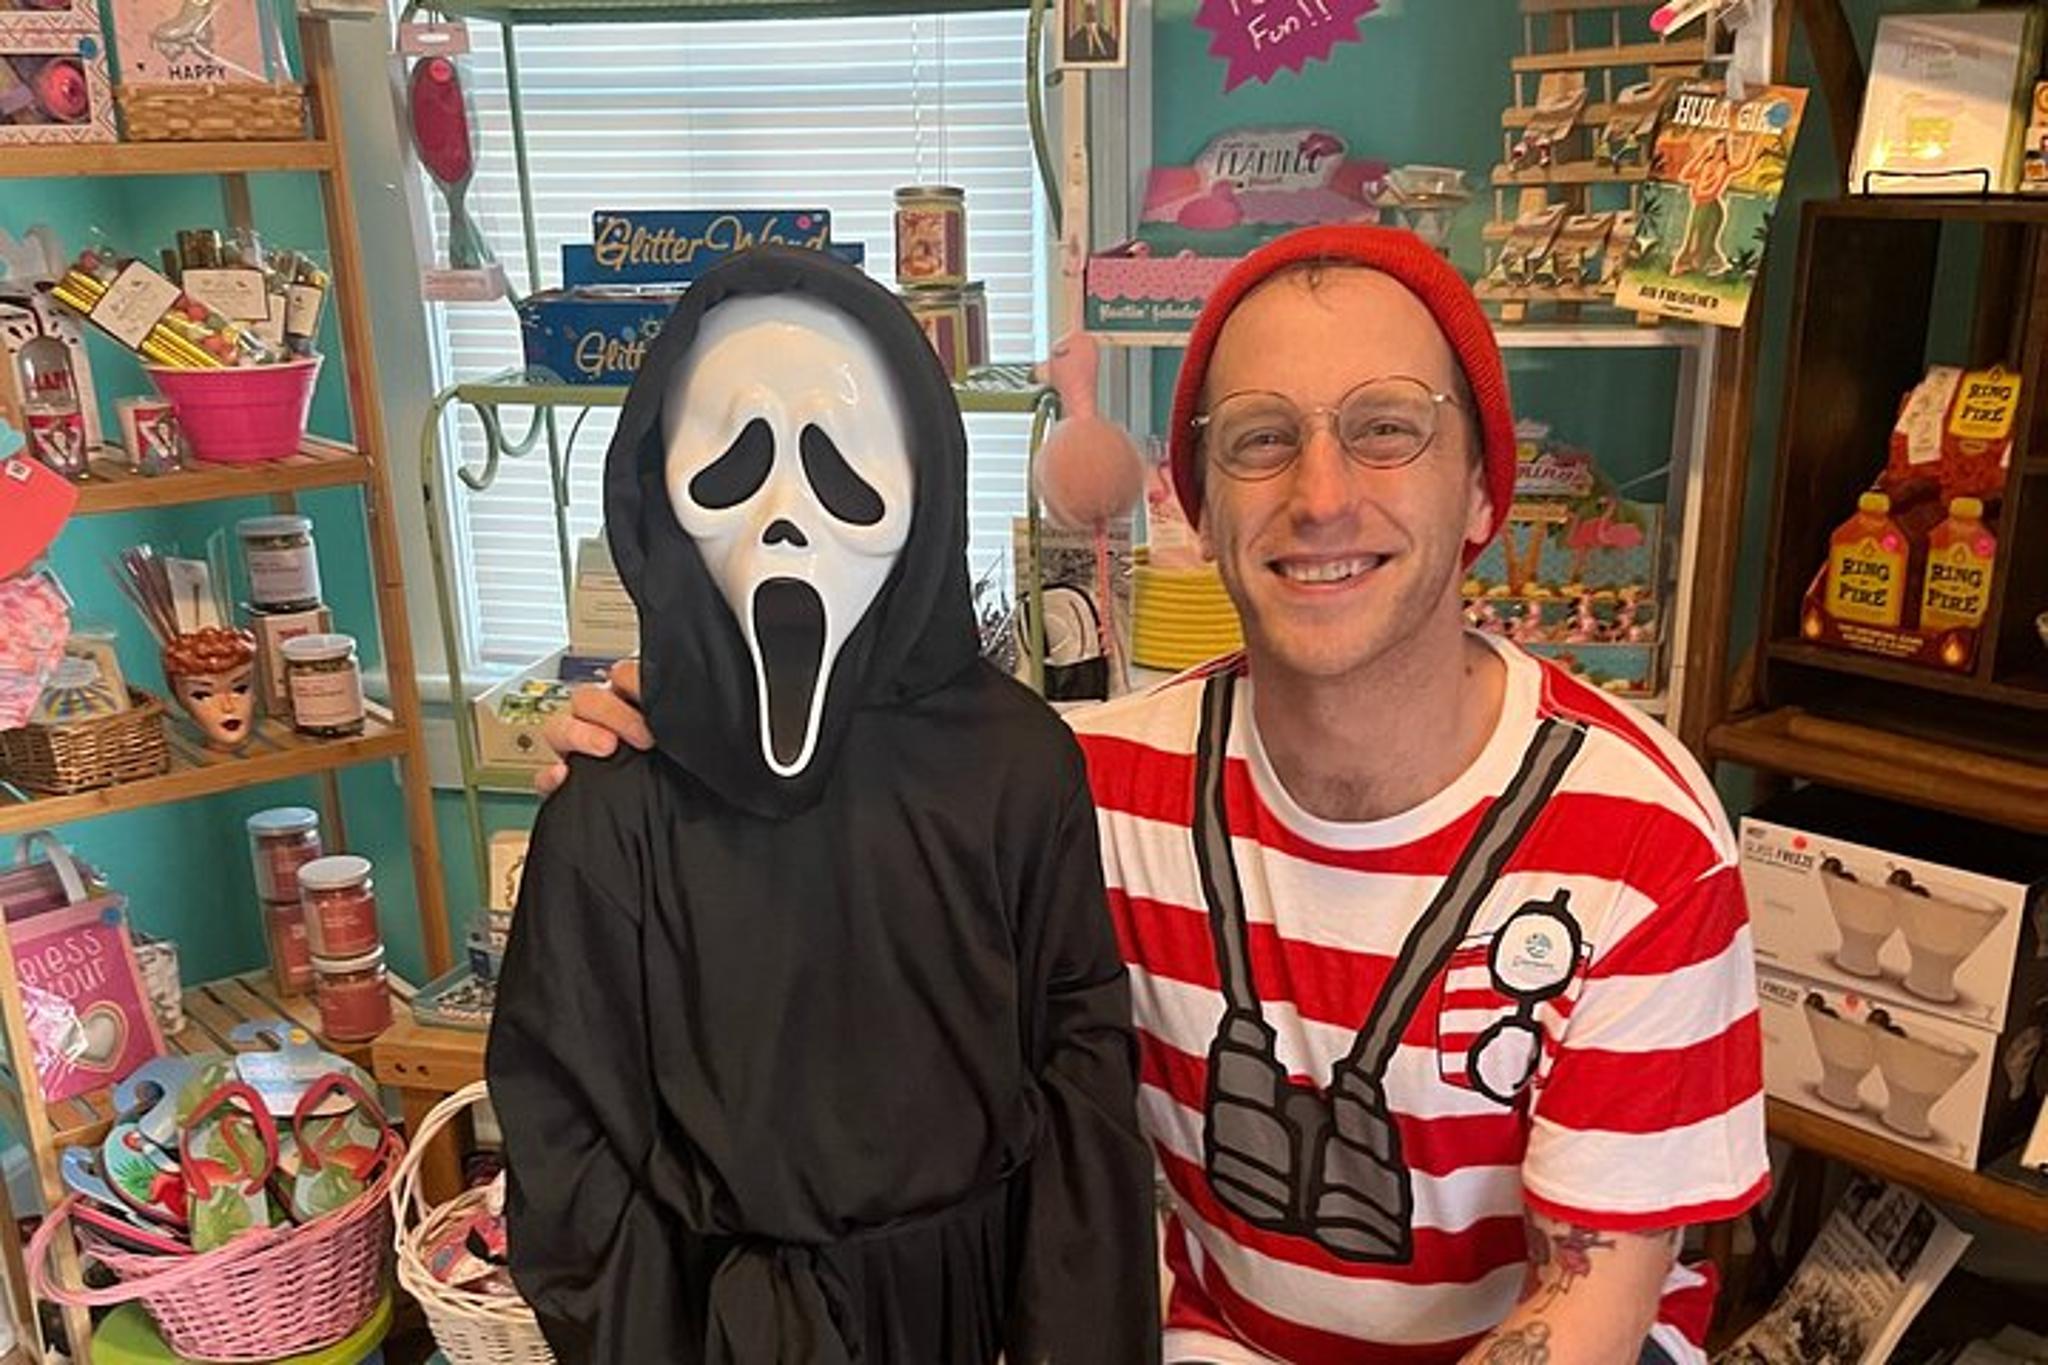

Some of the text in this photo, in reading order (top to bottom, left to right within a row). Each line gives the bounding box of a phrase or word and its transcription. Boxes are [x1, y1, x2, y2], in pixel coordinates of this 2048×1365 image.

[167, 65, 226, 80] HAPPY
[1672, 94, 1731, 129] HULA
[594, 217, 703, 271] Glitter
[574, 331, 648, 379] Glitt
[1840, 558, 1890, 582] RING
[1930, 563, 1984, 588] RING
[1838, 582, 1888, 607] FIRE
[1926, 587, 1980, 614] FIRE
[46, 957, 107, 1000] our
